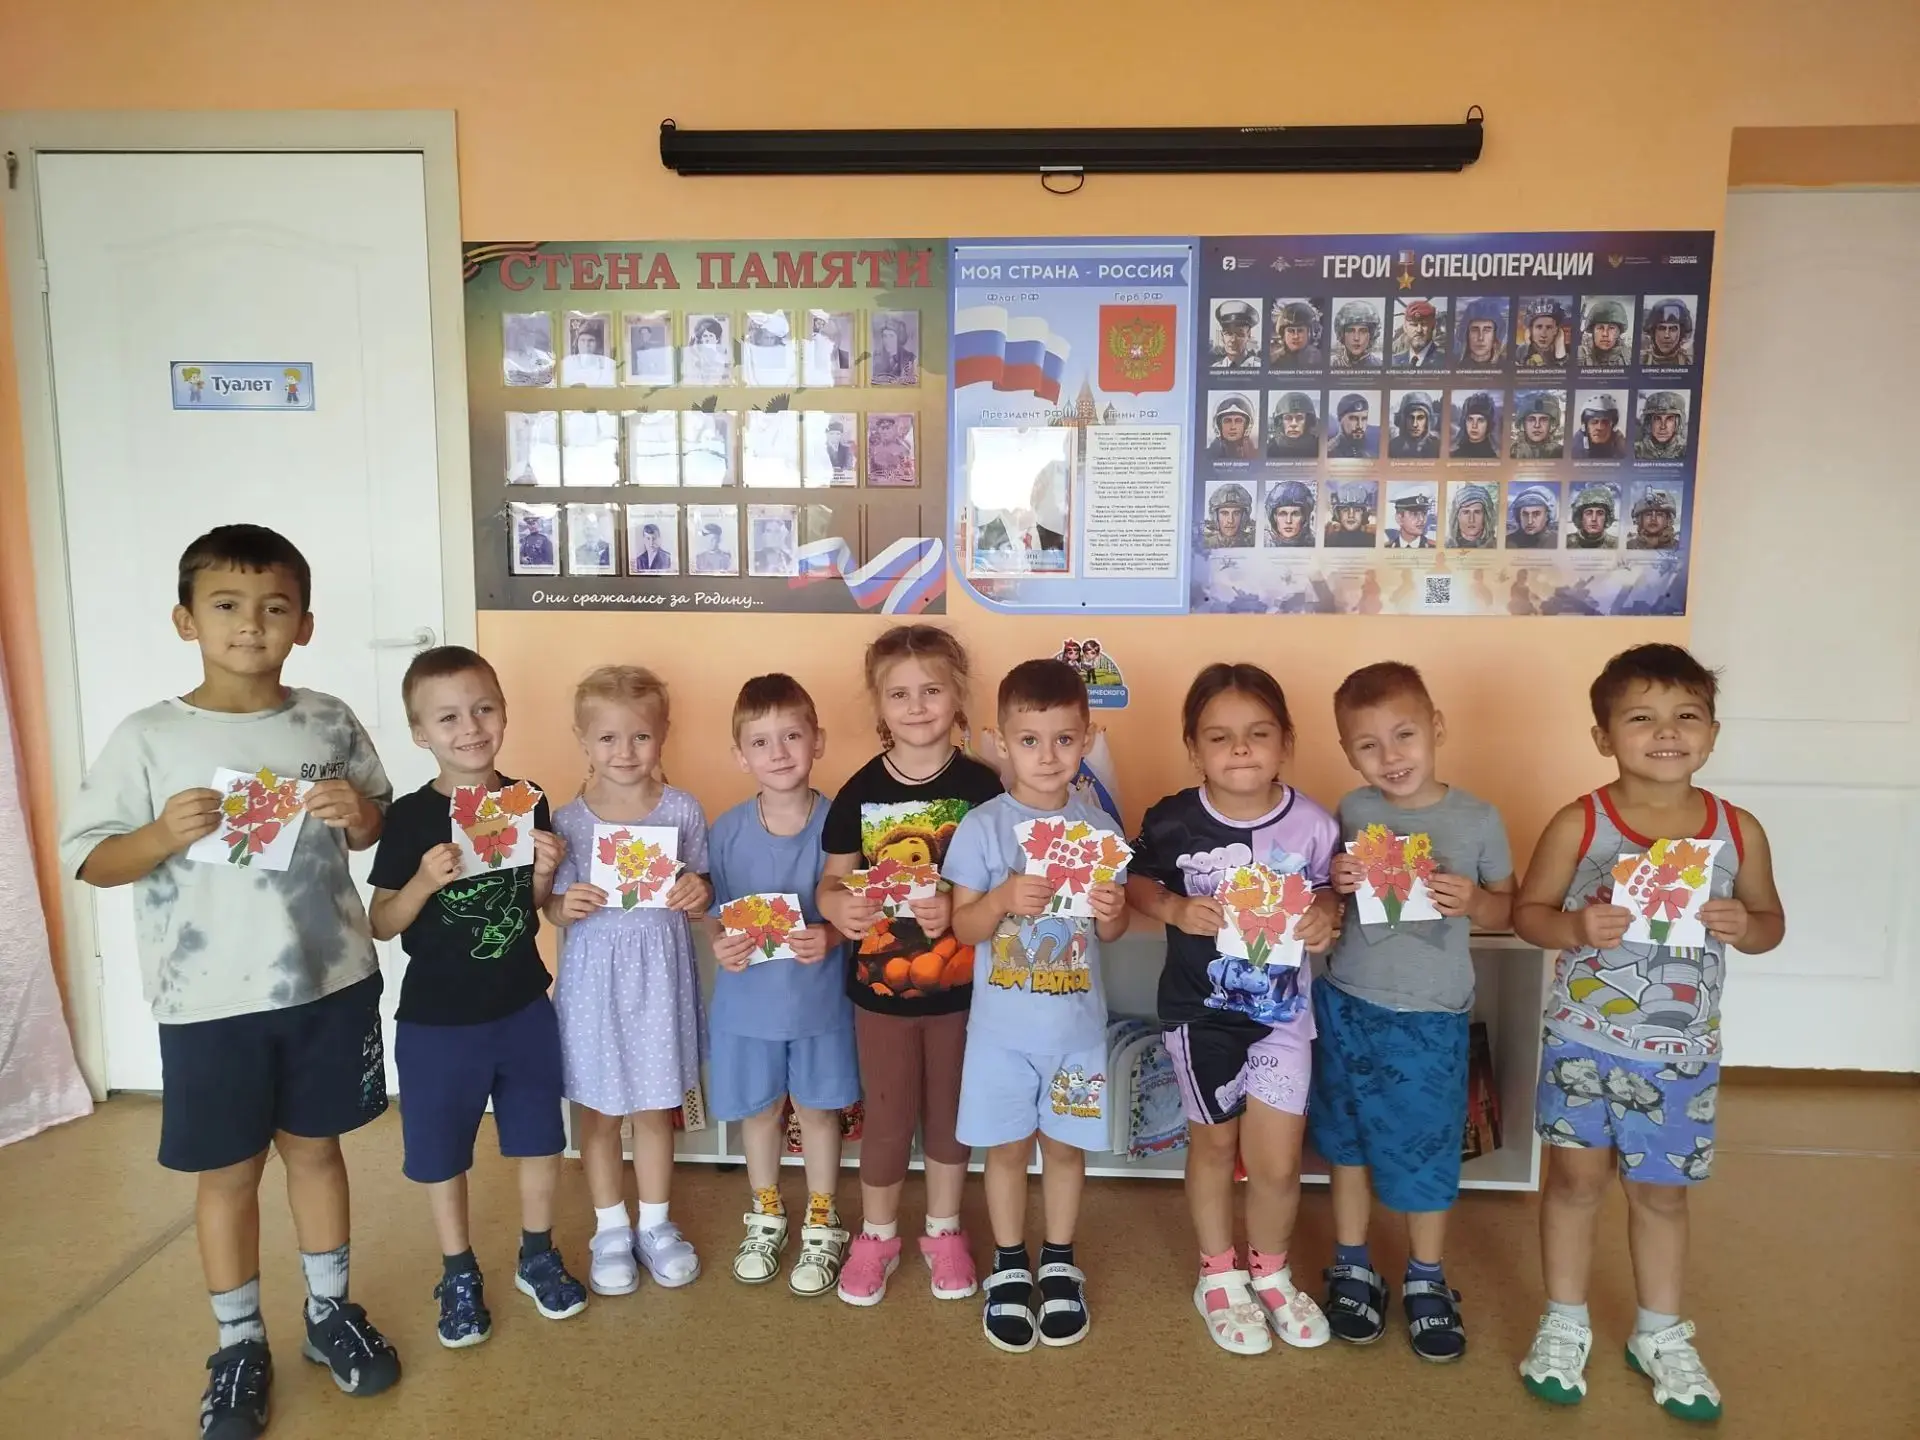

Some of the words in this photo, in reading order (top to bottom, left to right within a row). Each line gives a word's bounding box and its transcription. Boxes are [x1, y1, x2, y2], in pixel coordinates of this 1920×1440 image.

[499, 252, 681, 291] СТЕНА
[696, 249, 933, 290] ПАМЯТИ
[961, 265, 1001, 280] МОЯ
[1008, 264, 1079, 279] СТРАНА
[1099, 264, 1174, 279] РОССИЯ
[1322, 254, 1391, 279] ГЕРОИ
[1420, 252, 1594, 281] СПЕЦОПЕРАЦИИ
[986, 292, 1016, 302] Флаг
[1020, 292, 1040, 302] РФ
[1114, 292, 1140, 304] Герб
[1143, 292, 1164, 302] РФ
[211, 376, 273, 394] Туалет
[982, 410, 1040, 420] Президент
[1044, 410, 1063, 419] РФ
[1139, 410, 1158, 419] РФ
[532, 590, 569, 605] Они
[572, 593, 666, 607] сражались
[670, 595, 690, 607] за
[694, 591, 764, 608] Родину...
[300, 762, 317, 778] SO
[1549, 1319, 1587, 1340] GAME
[1655, 1326, 1686, 1345] GAME
